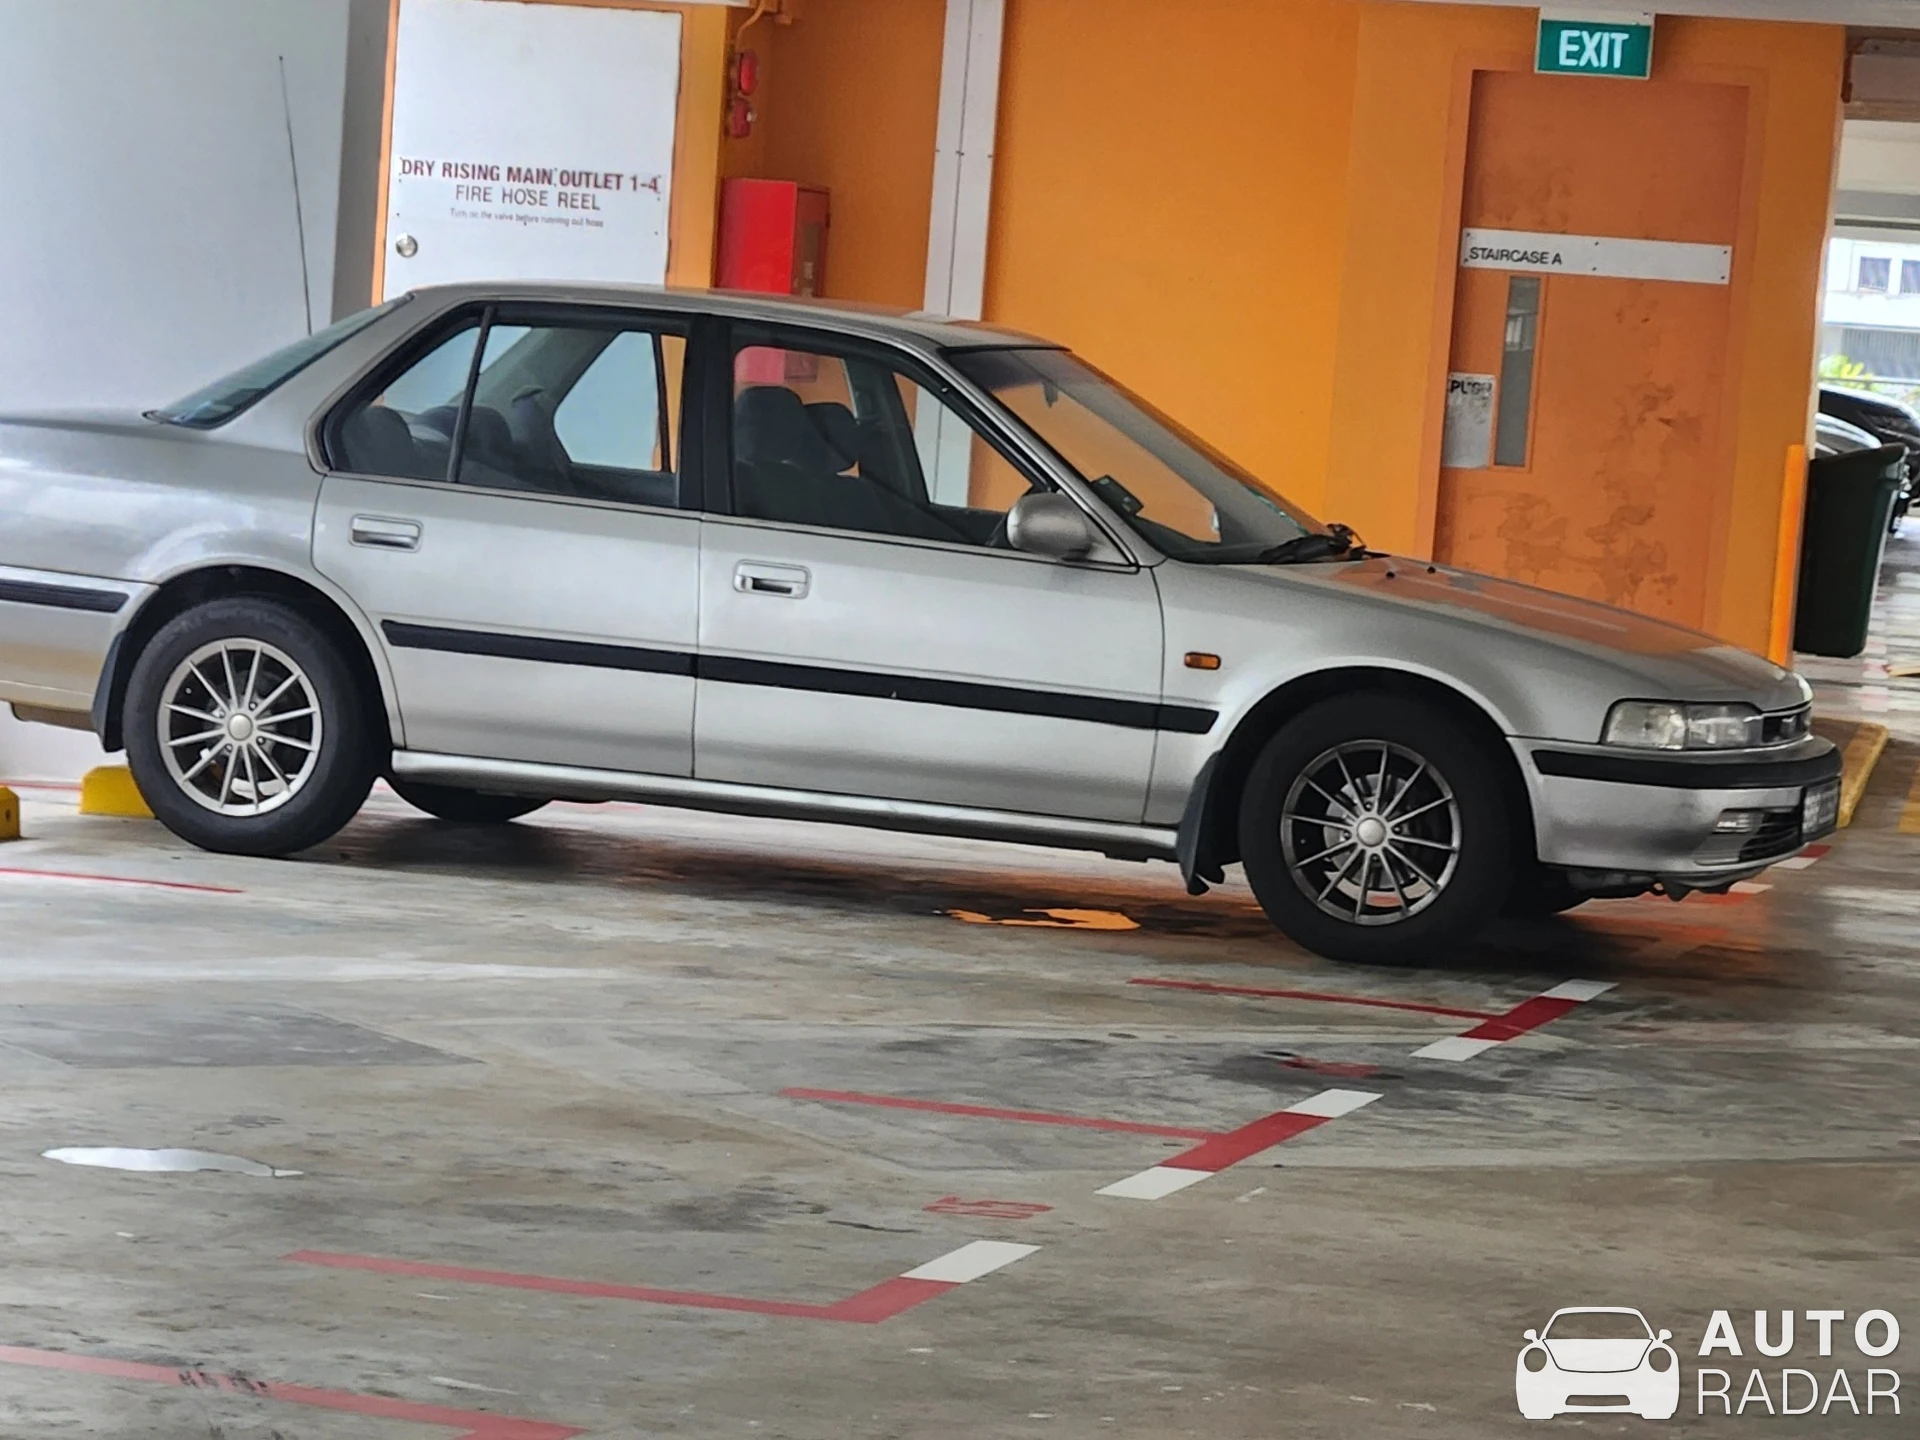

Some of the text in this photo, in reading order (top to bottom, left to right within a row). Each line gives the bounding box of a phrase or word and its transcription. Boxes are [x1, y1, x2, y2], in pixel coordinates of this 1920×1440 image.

[1559, 29, 1630, 68] EXIT
[401, 158, 659, 193] DRY RISING MAIN OUTLET 1-4
[455, 184, 601, 211] FIRE HOSE REEL
[450, 207, 467, 218] Turn
[481, 210, 492, 219] the
[495, 212, 514, 222] valve
[516, 213, 540, 223] before
[541, 216, 570, 227] running
[1469, 246, 1563, 265] STAIRCASE A
